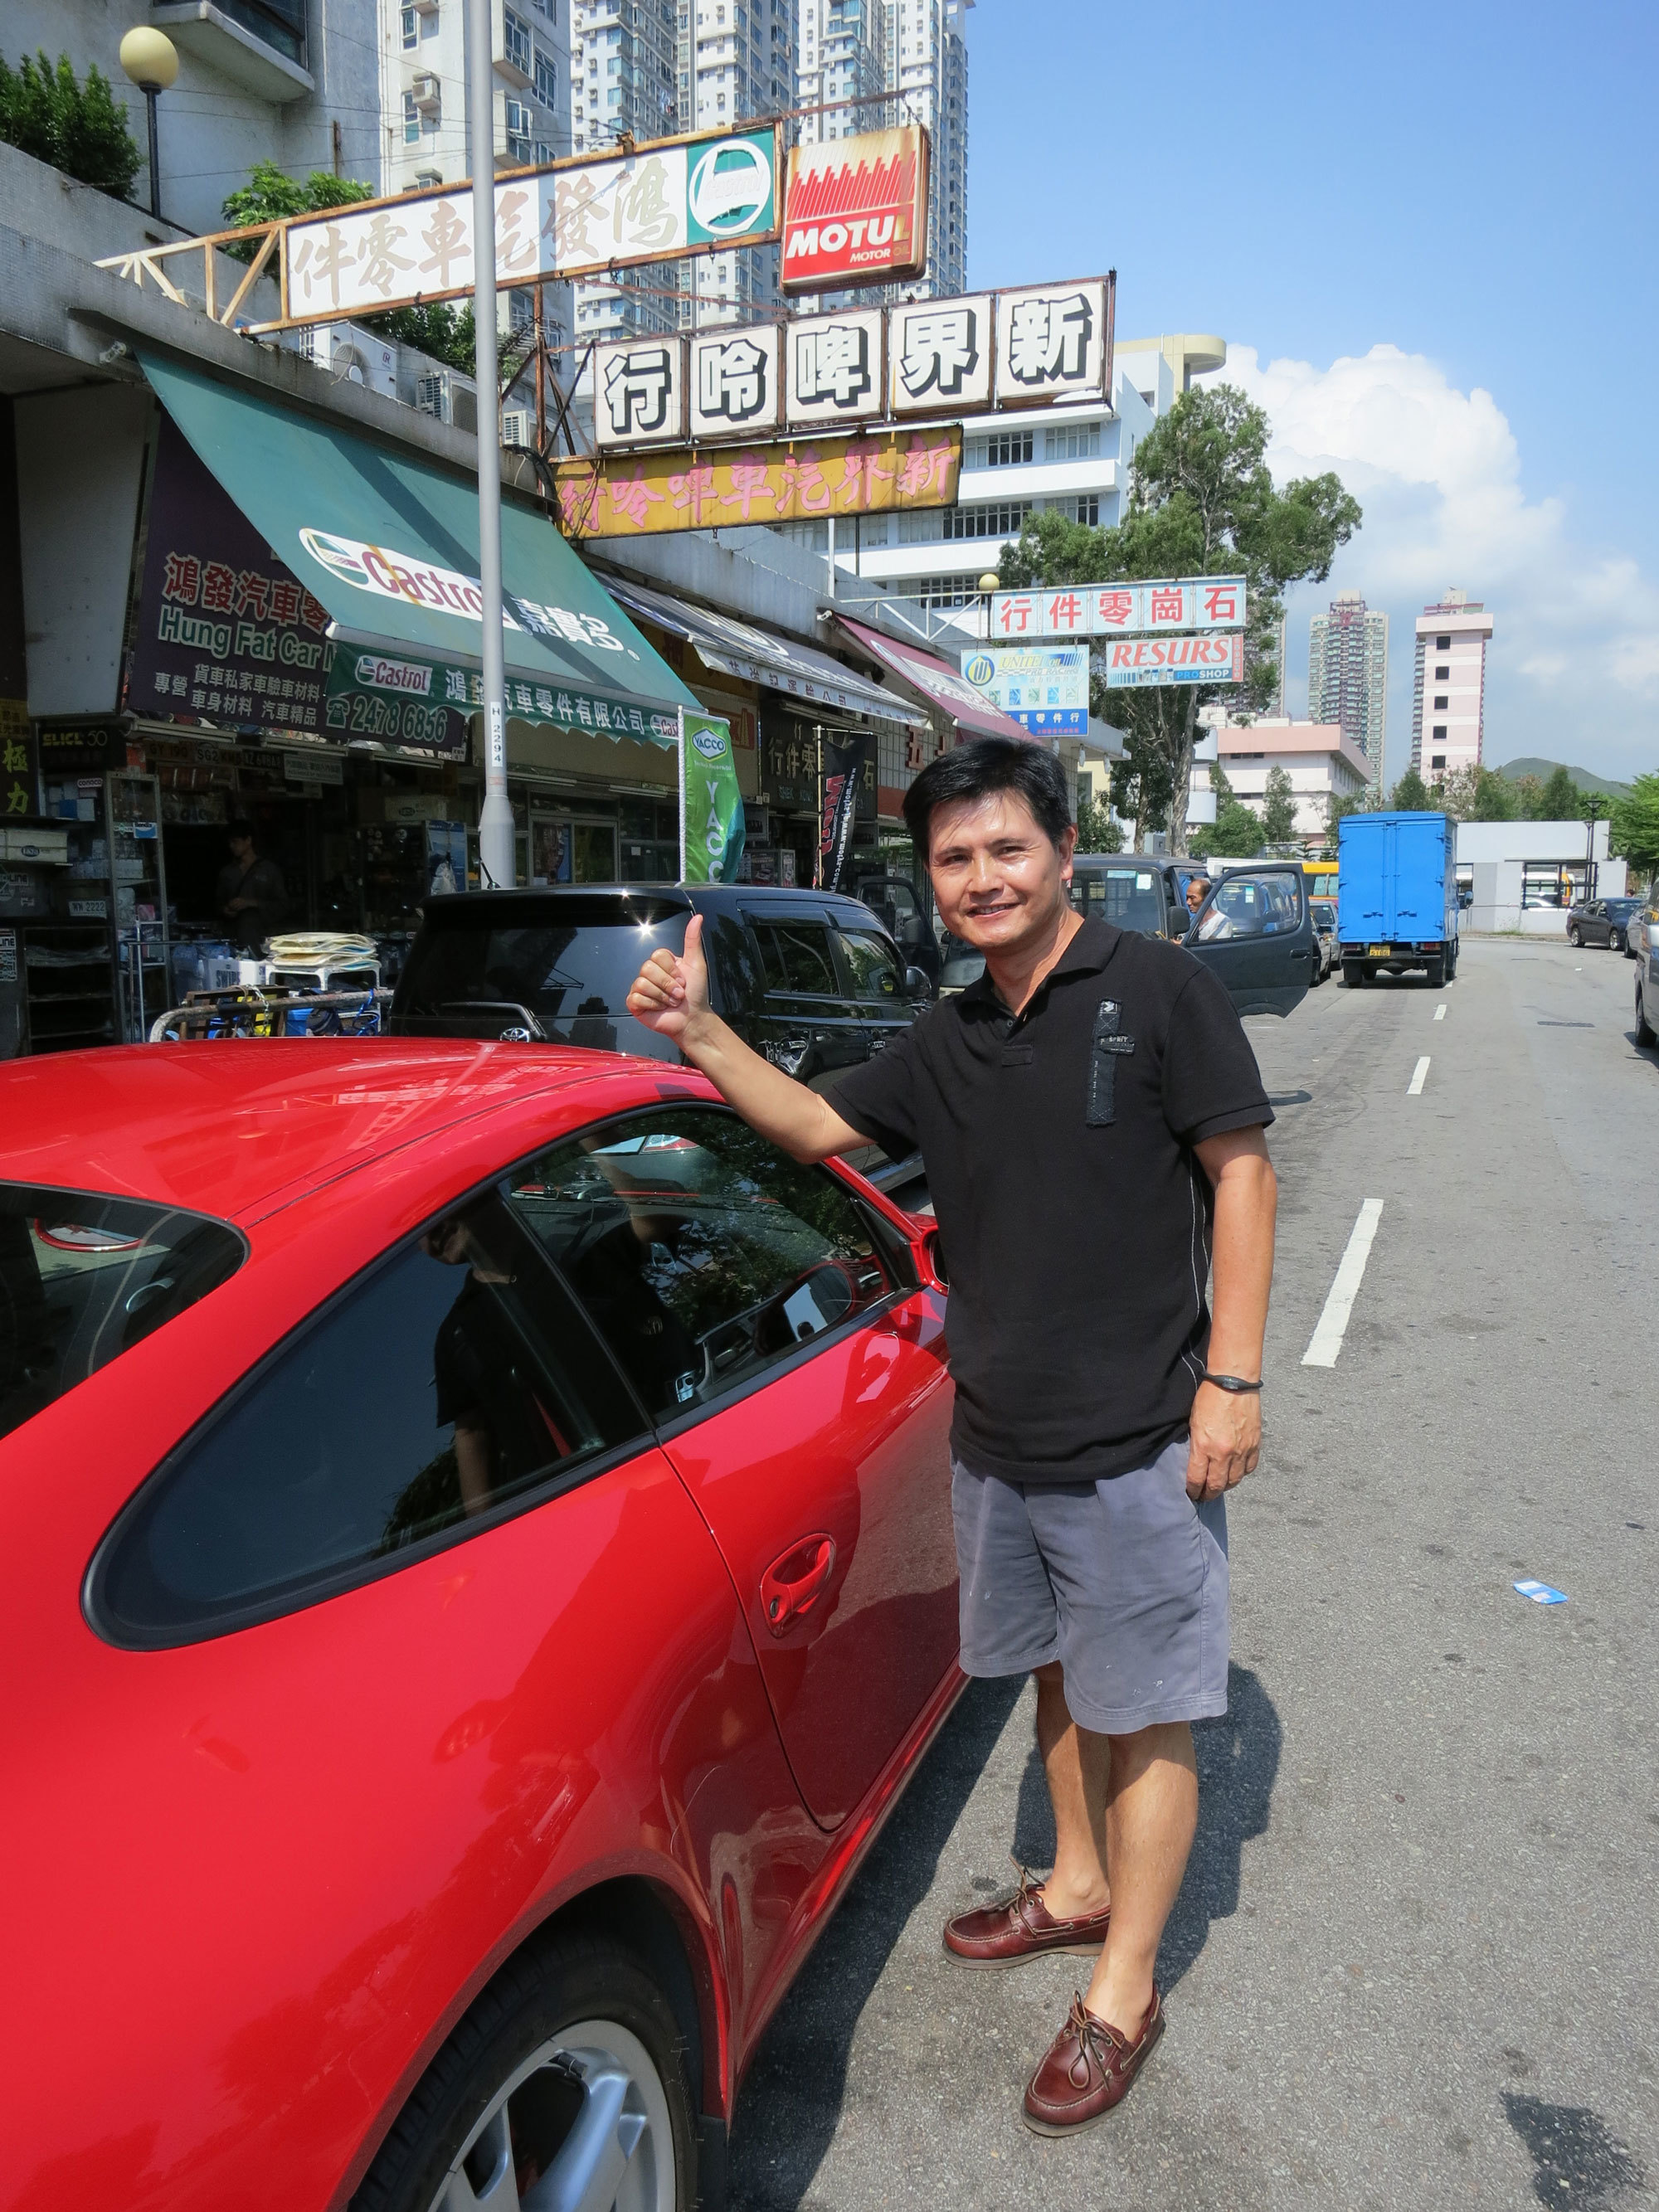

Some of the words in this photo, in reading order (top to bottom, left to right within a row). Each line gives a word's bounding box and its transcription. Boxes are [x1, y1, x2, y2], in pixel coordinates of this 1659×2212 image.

[786, 214, 912, 259] MOTUL
[849, 248, 891, 263] MOTOR
[362, 551, 510, 622] Castro
[158, 605, 232, 660] Hung
[235, 620, 278, 661] Fat
[279, 631, 322, 670] Car
[1111, 639, 1228, 668] RESURS
[154, 672, 188, 698] 專營
[375, 661, 428, 692] Castrol
[191, 689, 253, 717] 車身材料
[261, 699, 318, 727] 汽車精品
[349, 695, 401, 737] 2478
[402, 702, 448, 745] 6856
[492, 707, 500, 716] H
[1010, 712, 1080, 724] 車零件行
[87, 730, 107, 746] 50
[493, 724, 502, 762] 2294
[693, 737, 725, 751] YACCO
